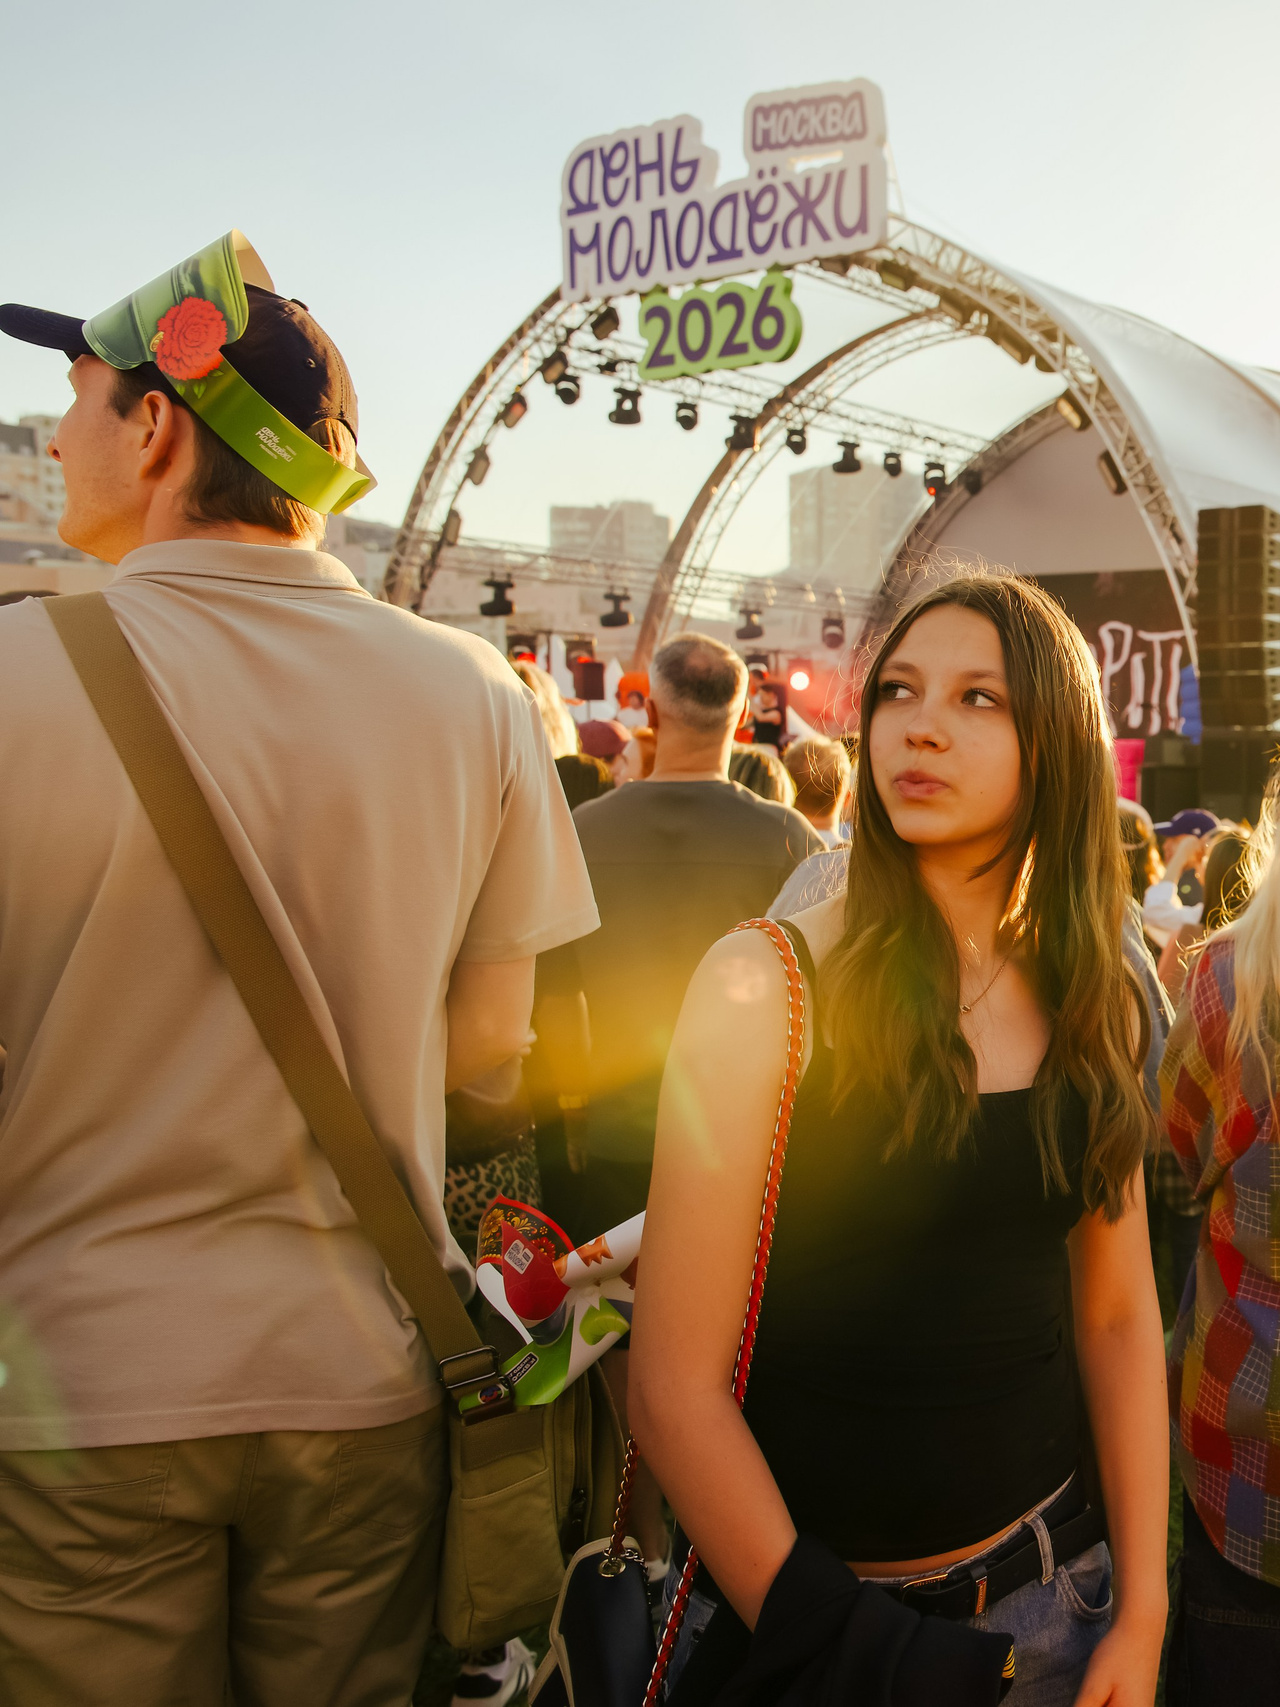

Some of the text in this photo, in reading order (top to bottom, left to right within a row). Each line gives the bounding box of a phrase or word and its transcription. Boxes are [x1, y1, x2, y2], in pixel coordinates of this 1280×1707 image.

[754, 97, 865, 147] МОСКВА
[566, 126, 701, 217] ДЕНЬ
[568, 163, 870, 290] МОЛОДЁЖИ
[643, 284, 787, 370] 2026
